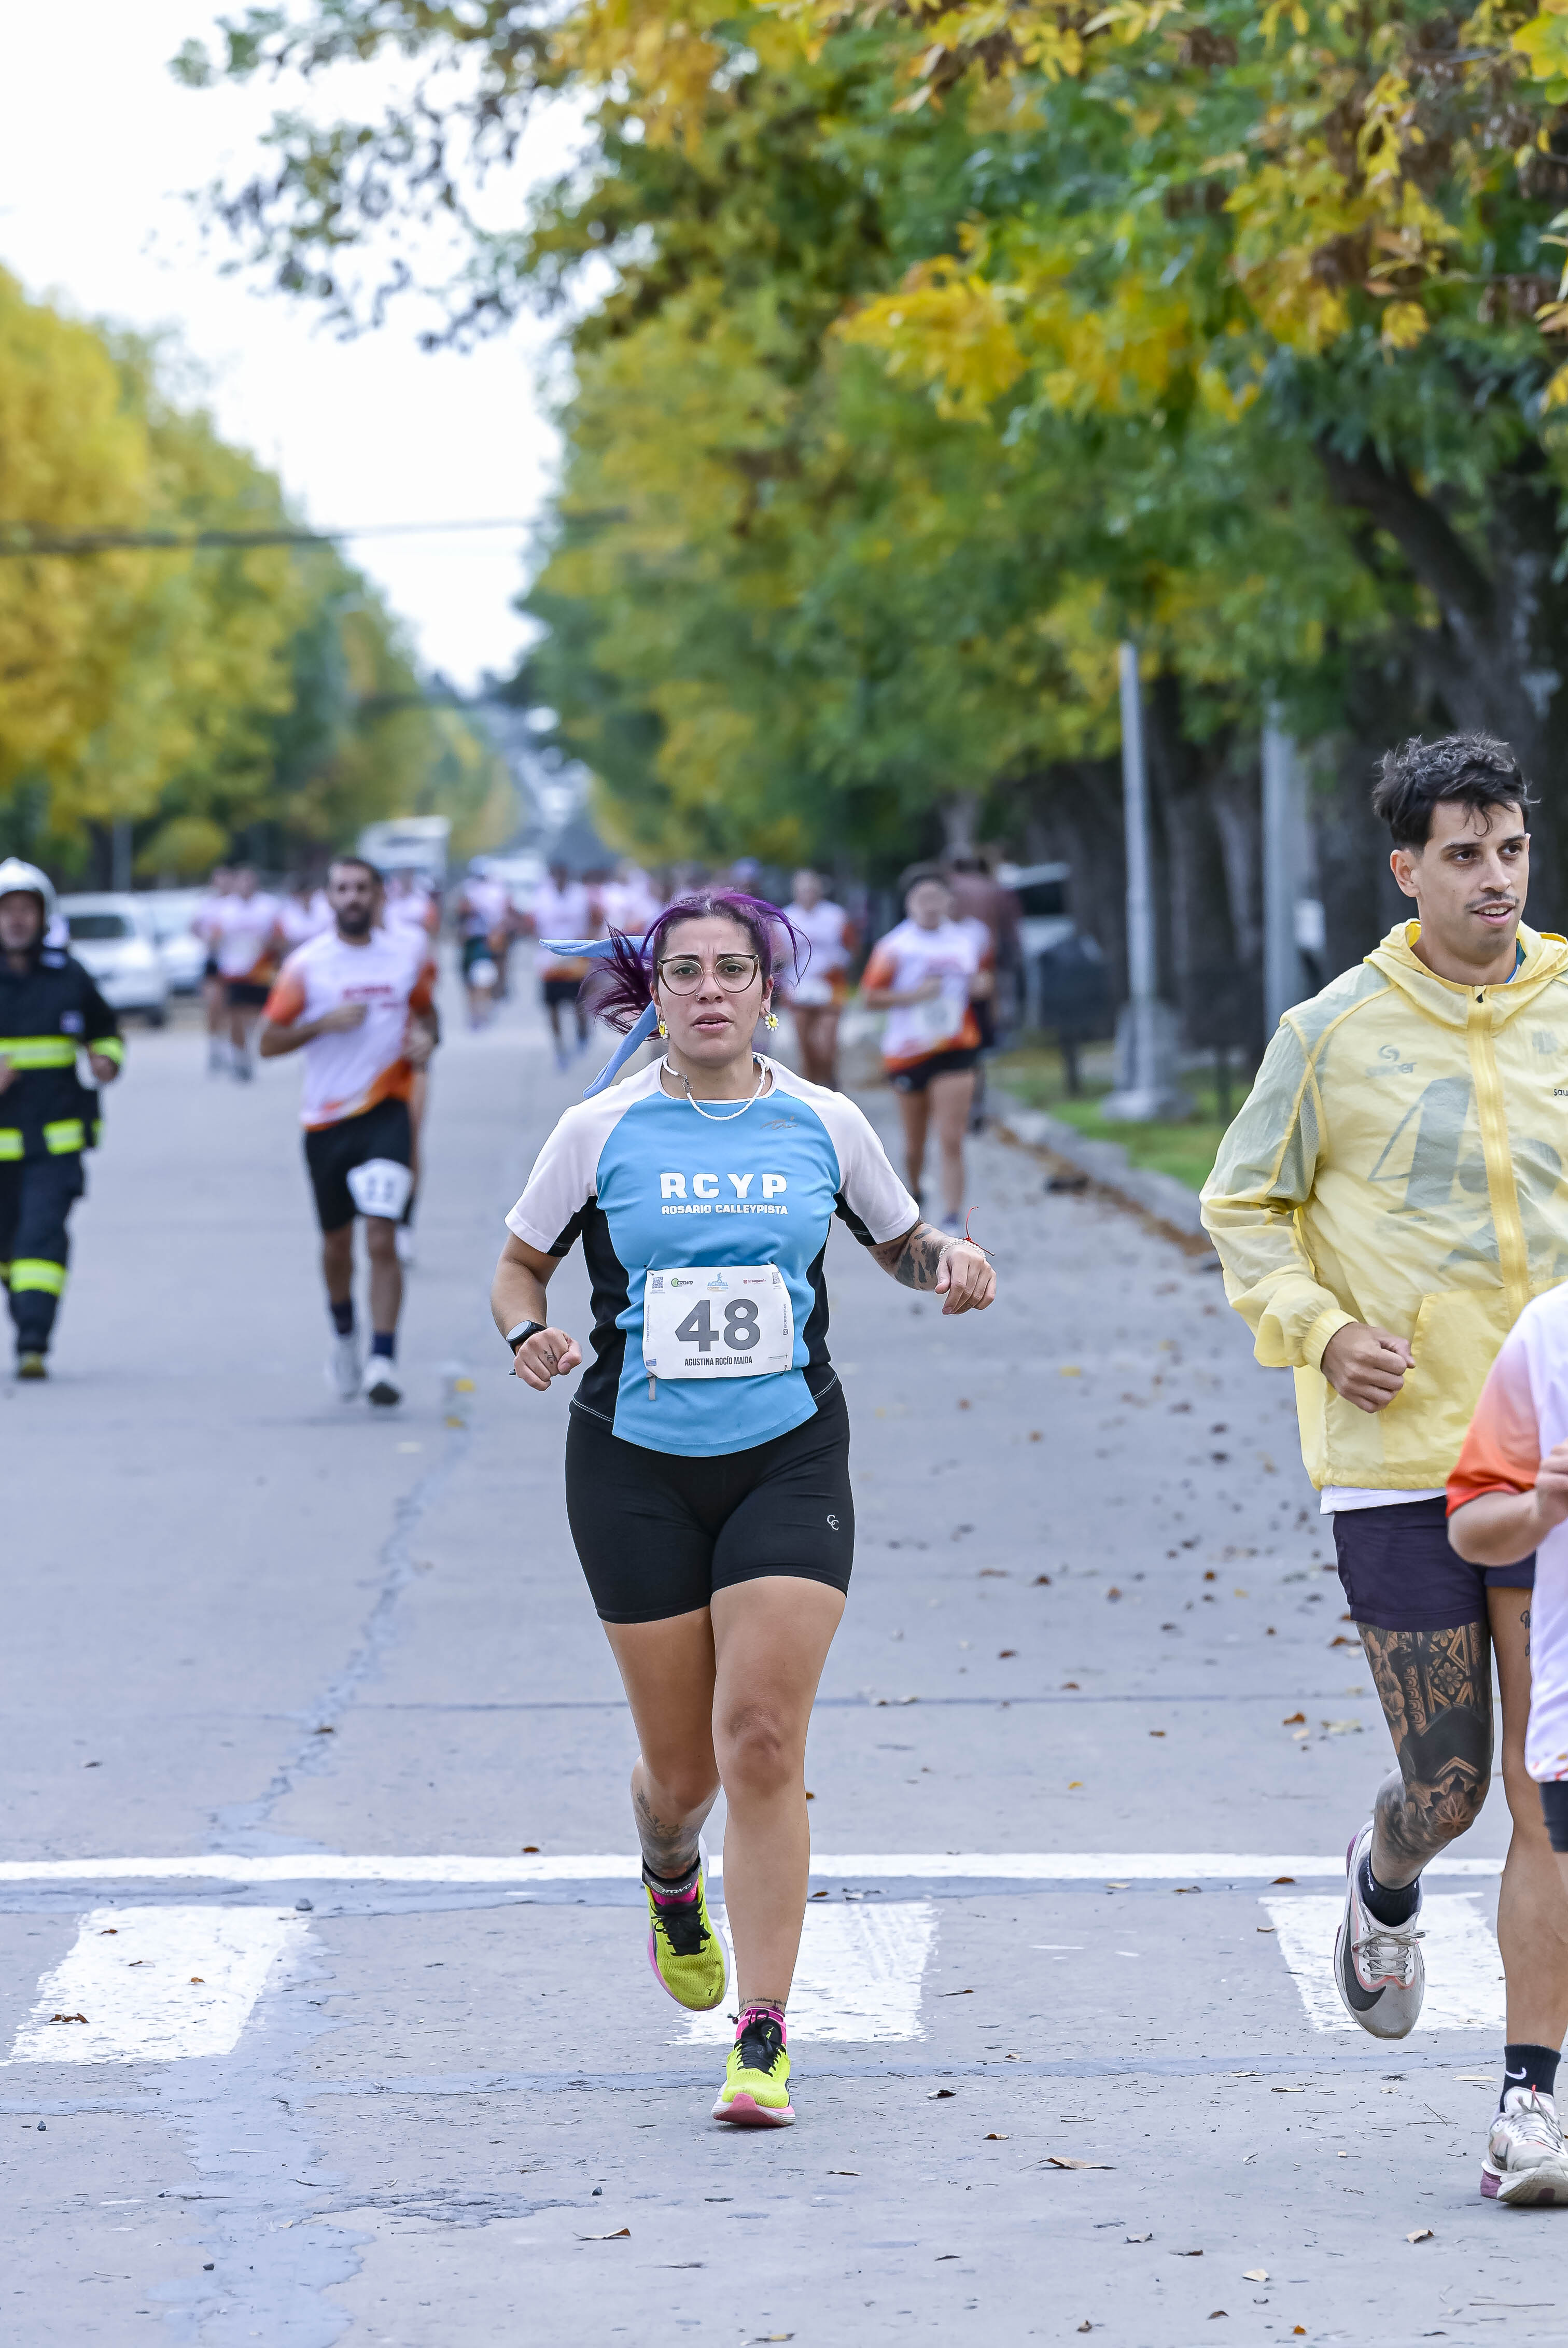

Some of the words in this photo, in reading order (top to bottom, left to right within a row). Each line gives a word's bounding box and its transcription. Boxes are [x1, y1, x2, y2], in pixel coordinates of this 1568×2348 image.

[660, 1172, 787, 1199] RCYP
[662, 1205, 712, 1215] ROSARIO
[715, 1204, 788, 1215] CALLEYPISTA
[675, 1299, 760, 1351] 48
[715, 1356, 733, 1365] ROCÍO
[734, 1356, 752, 1364] MAIDA
